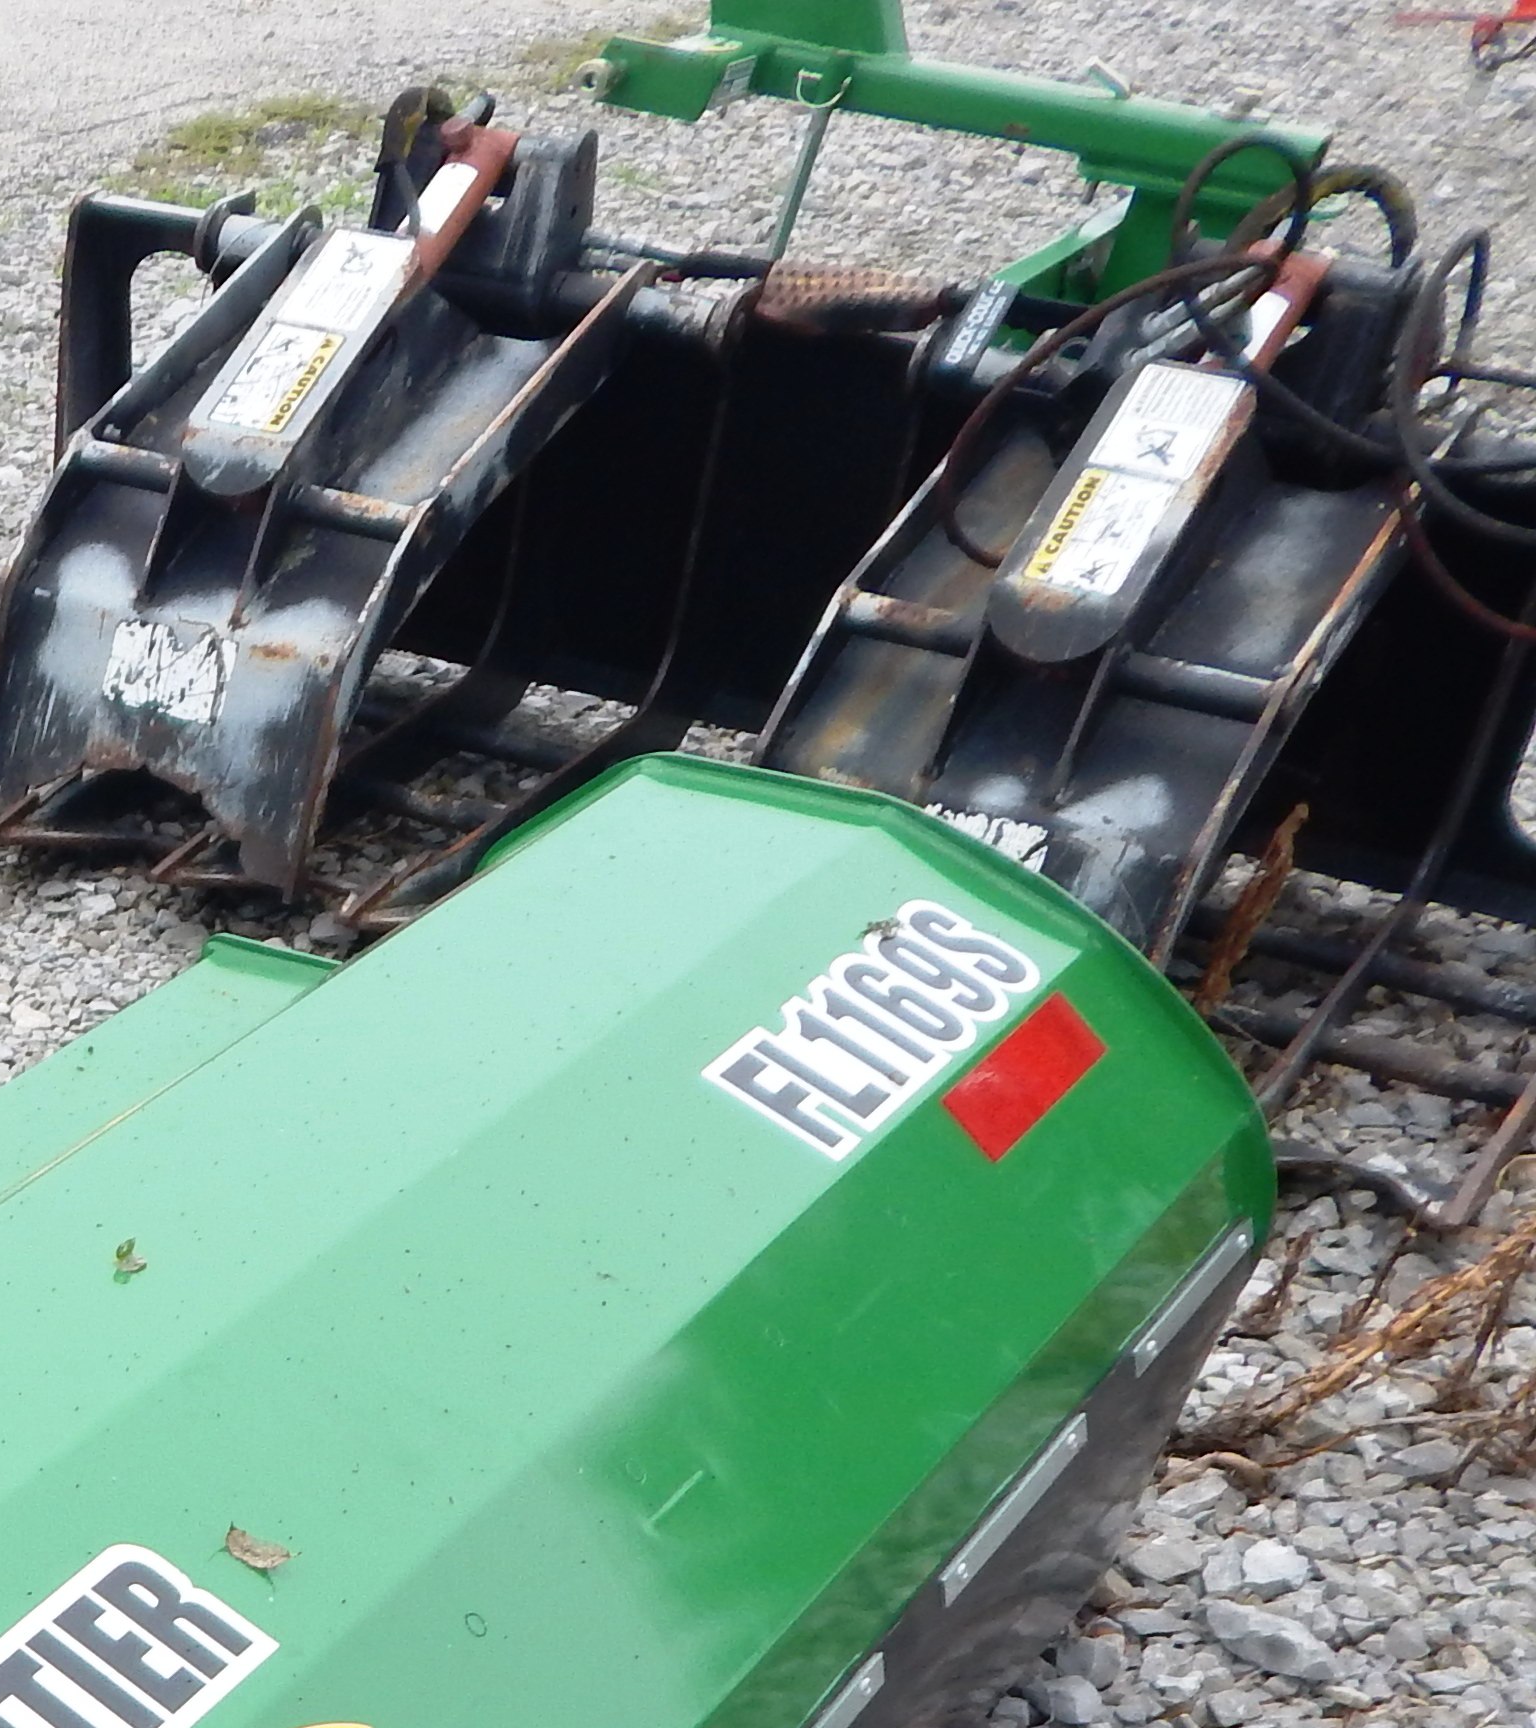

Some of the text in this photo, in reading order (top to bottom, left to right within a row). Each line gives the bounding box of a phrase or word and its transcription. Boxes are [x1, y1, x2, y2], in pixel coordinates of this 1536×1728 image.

[270, 356, 325, 426] CAUTION
[1044, 476, 1102, 556] CAUTION
[719, 909, 1028, 1149] FL1169S
